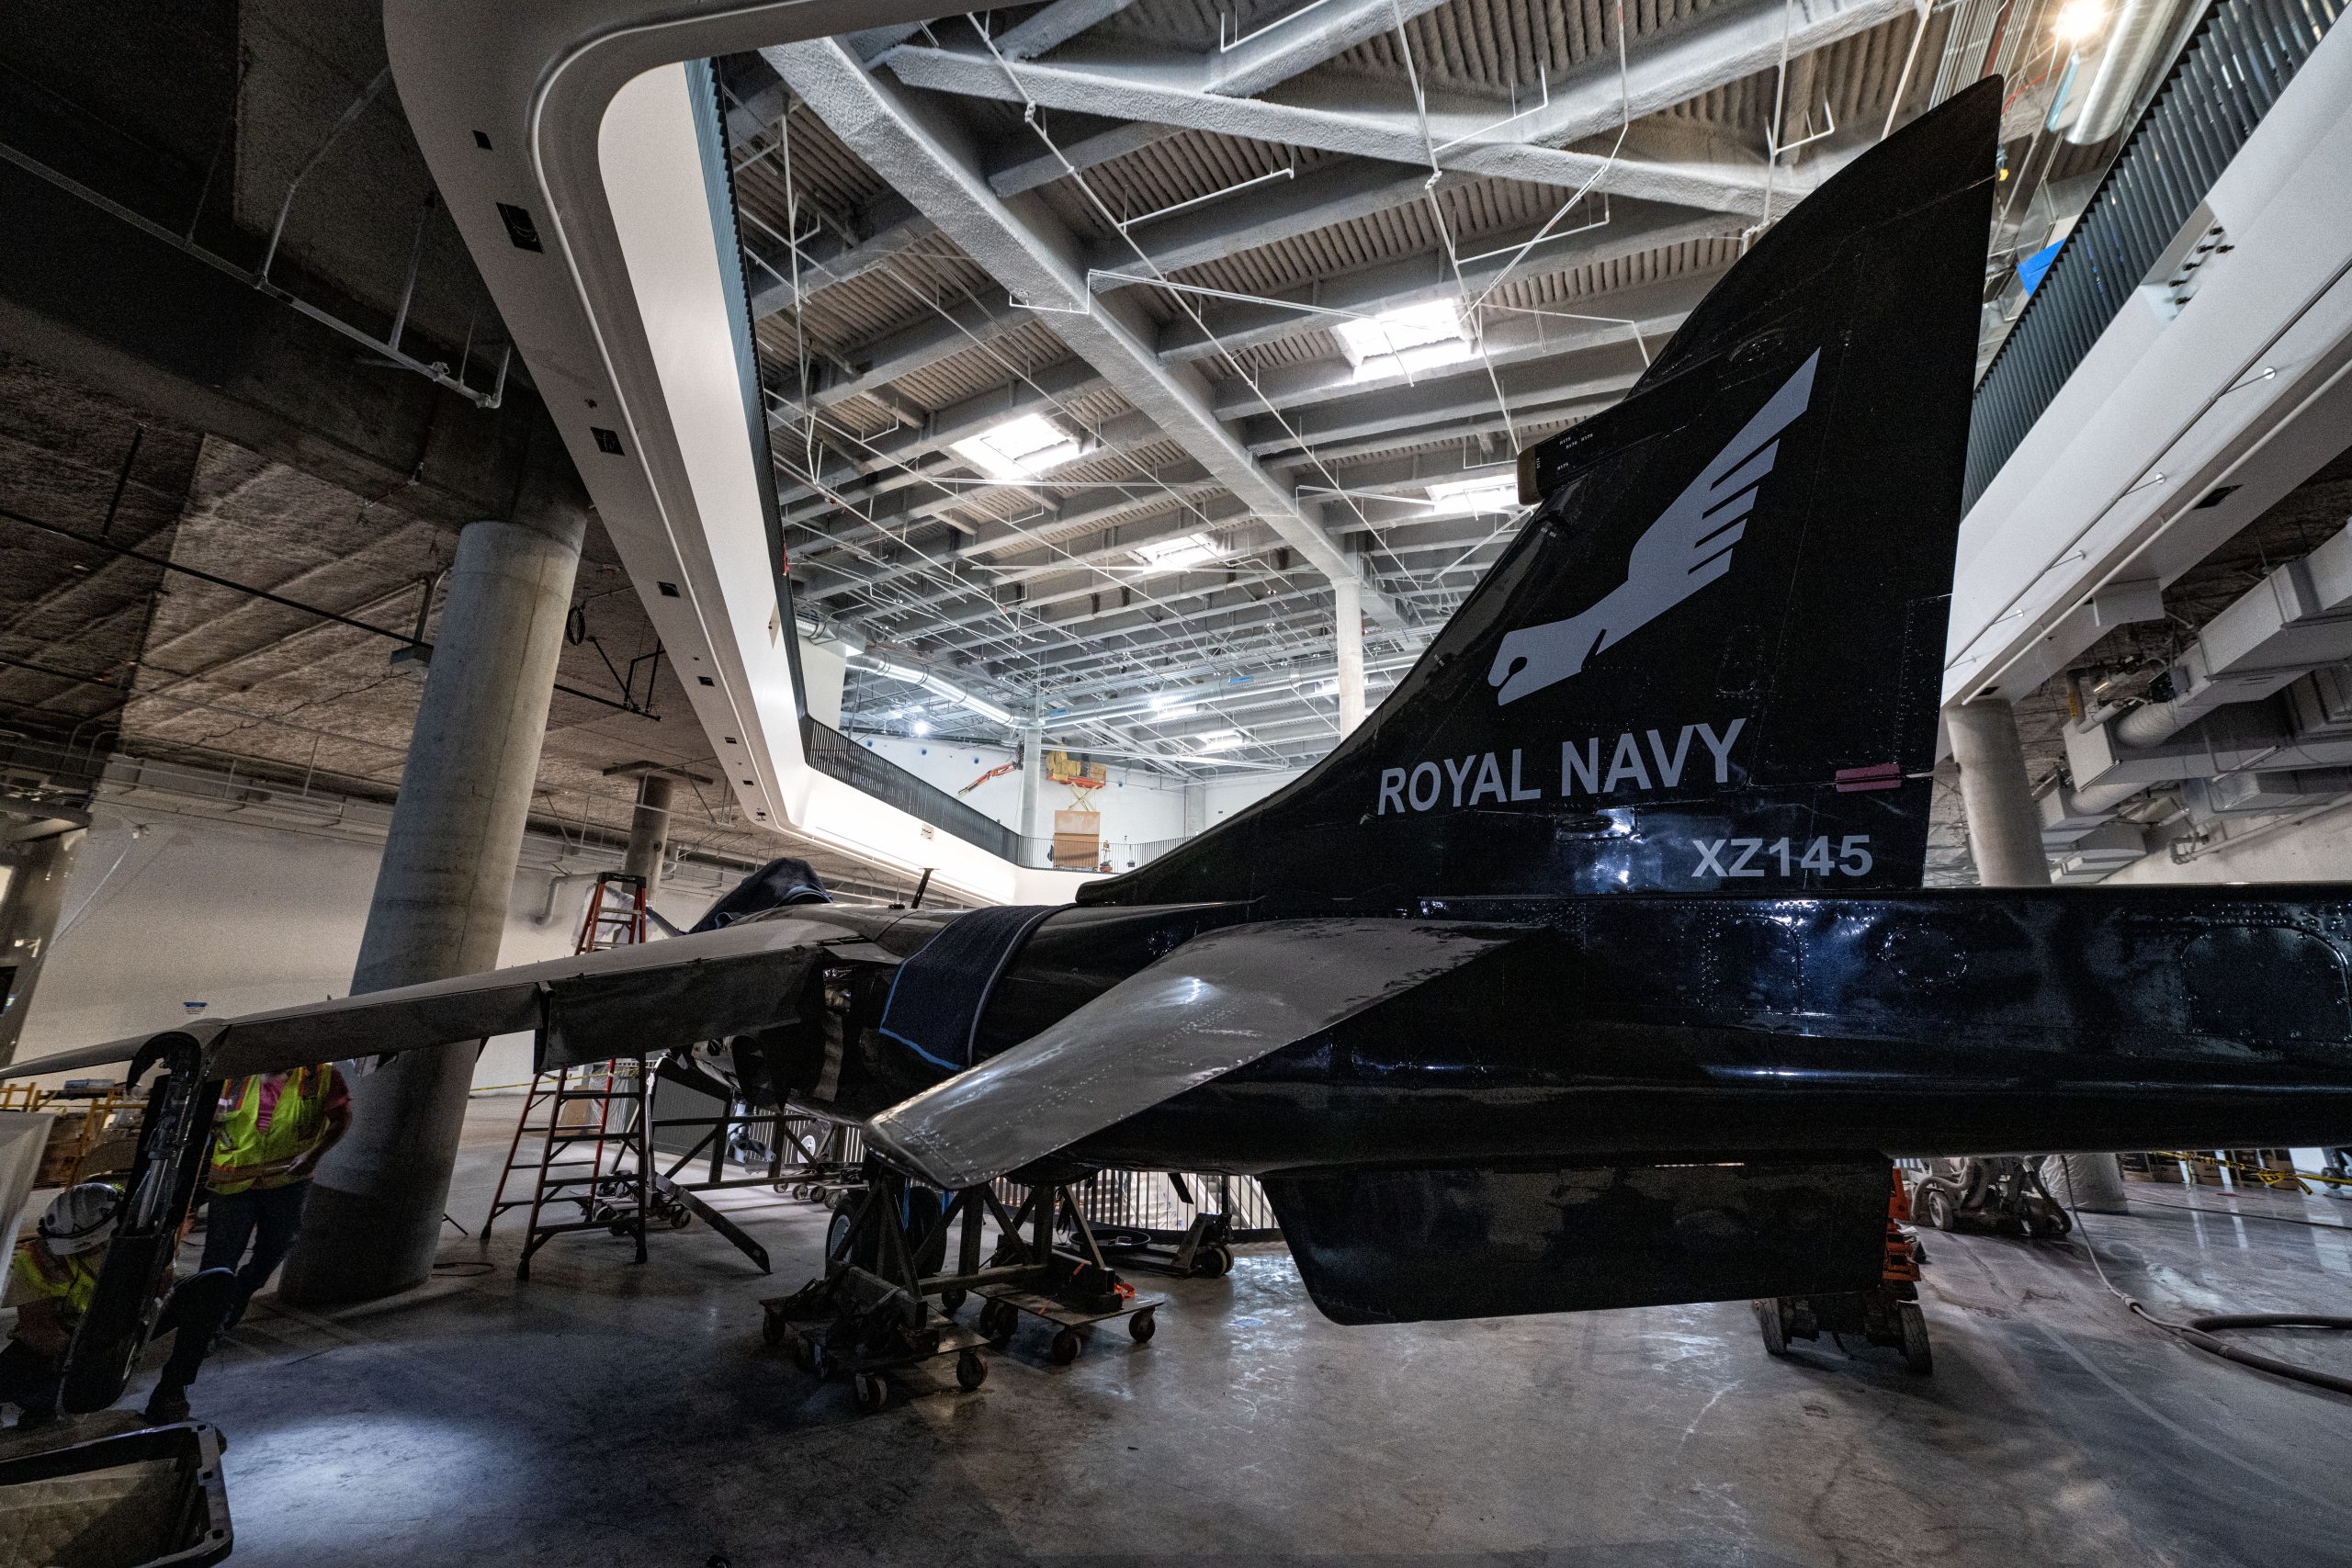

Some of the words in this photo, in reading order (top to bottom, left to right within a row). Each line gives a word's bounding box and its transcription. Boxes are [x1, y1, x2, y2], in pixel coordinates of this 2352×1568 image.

[1377, 749, 1542, 816] ROYAL
[1562, 718, 1747, 796] NAVY
[1691, 834, 1873, 878] XZ145
